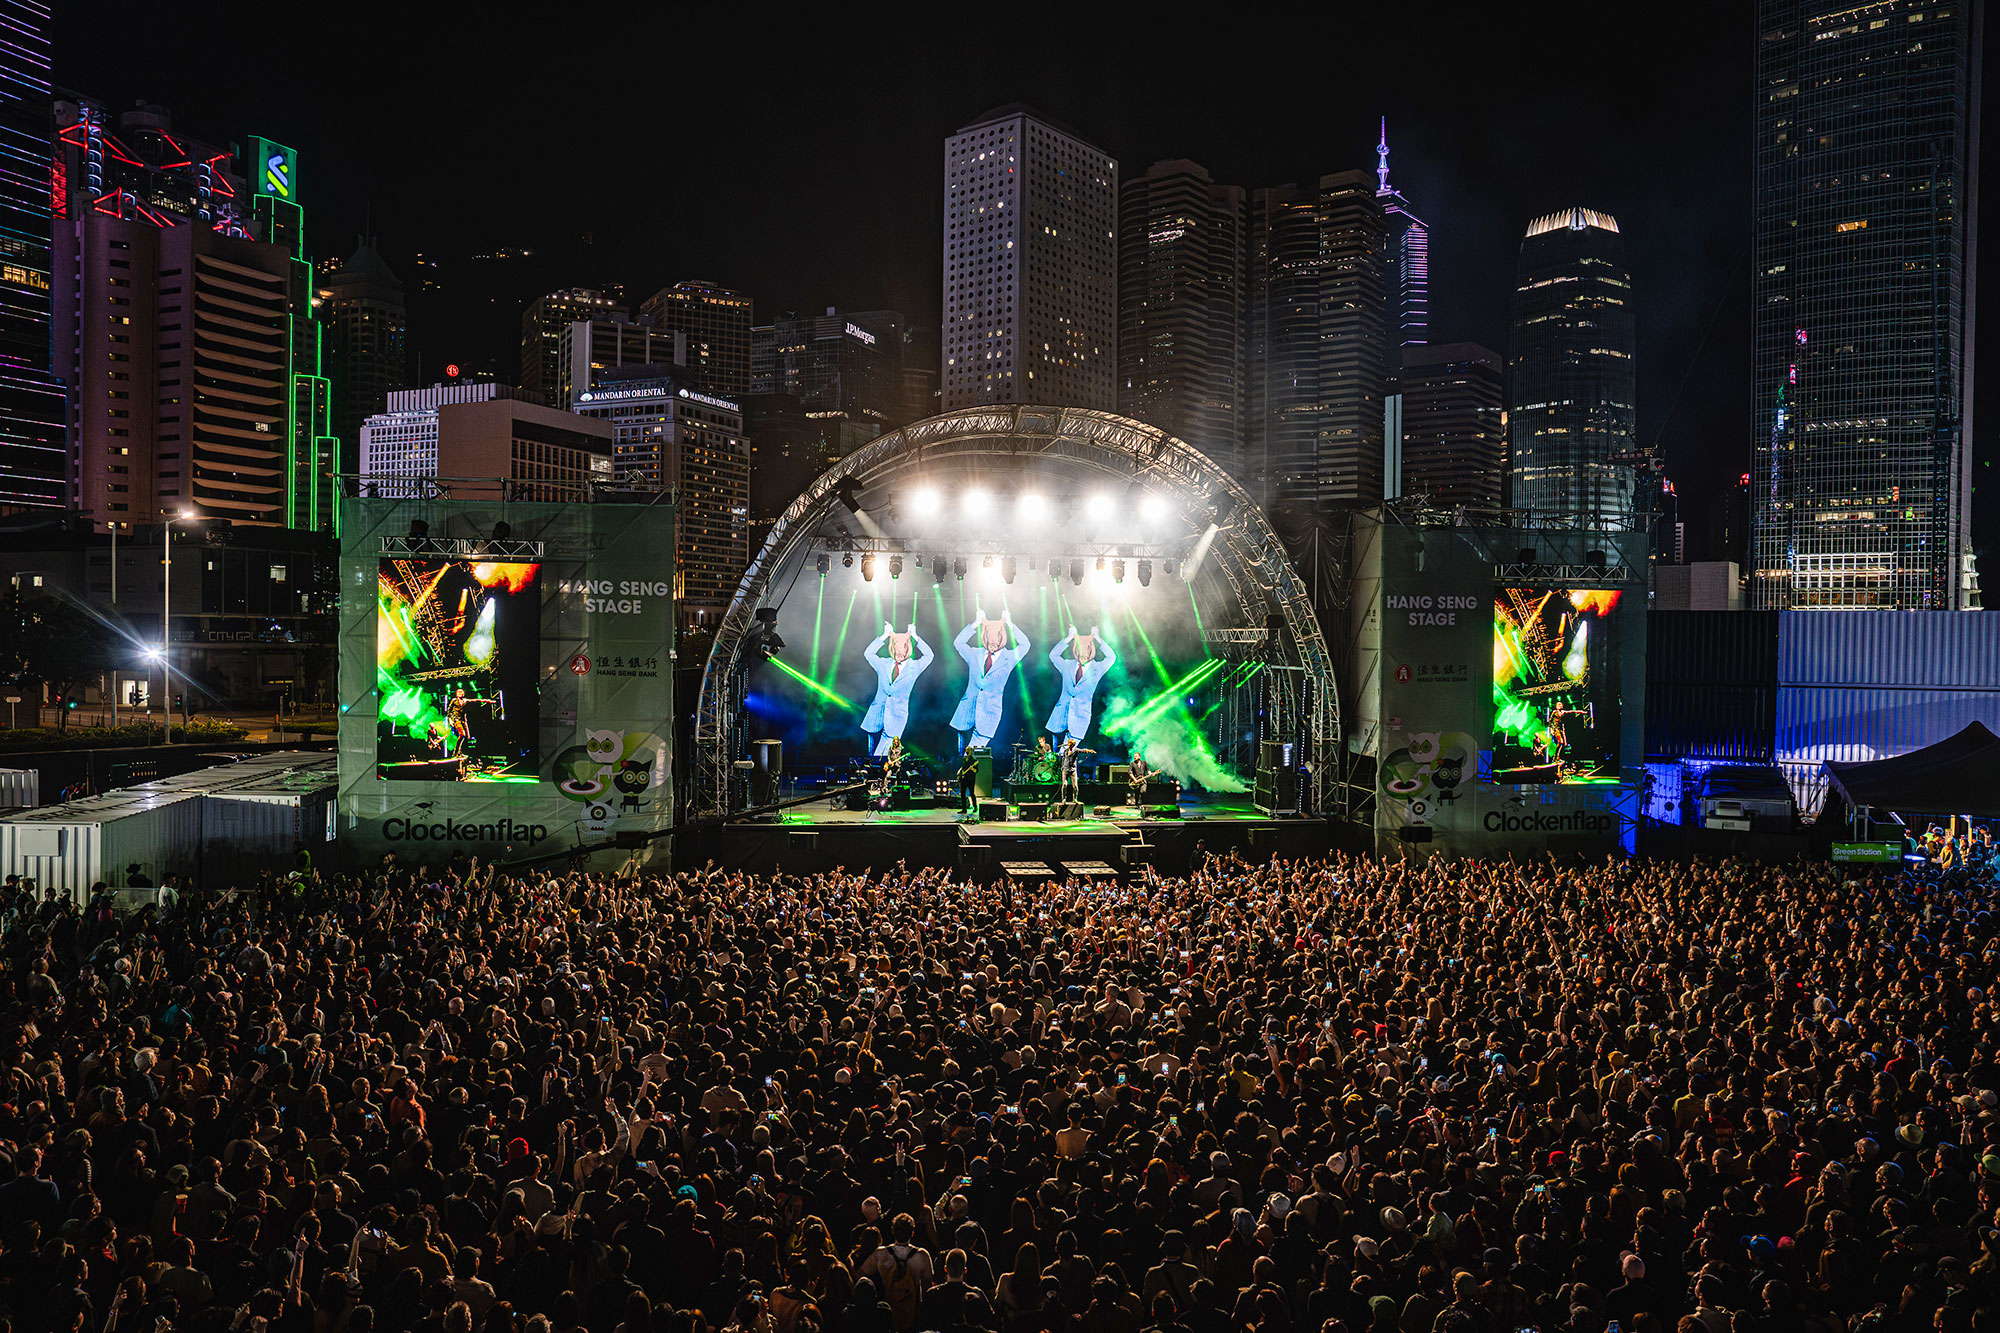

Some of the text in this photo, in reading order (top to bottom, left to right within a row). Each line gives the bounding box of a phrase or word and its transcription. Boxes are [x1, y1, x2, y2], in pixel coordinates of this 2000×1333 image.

[594, 387, 666, 400] MANDARIN ORIENTAL
[689, 391, 739, 412] MANDARIN ORIENTAL
[559, 580, 668, 596] HANG SENG
[585, 599, 642, 614] STAGE
[1386, 595, 1478, 609] HANG SENG
[1408, 613, 1455, 626] STAGE
[208, 631, 234, 641] CITY
[597, 656, 658, 669] 恒生銀行
[1483, 810, 1612, 835] Clockenflap
[382, 818, 547, 847] Clockenflap
[1833, 847, 1856, 855] Green
[1857, 848, 1882, 856] Station
